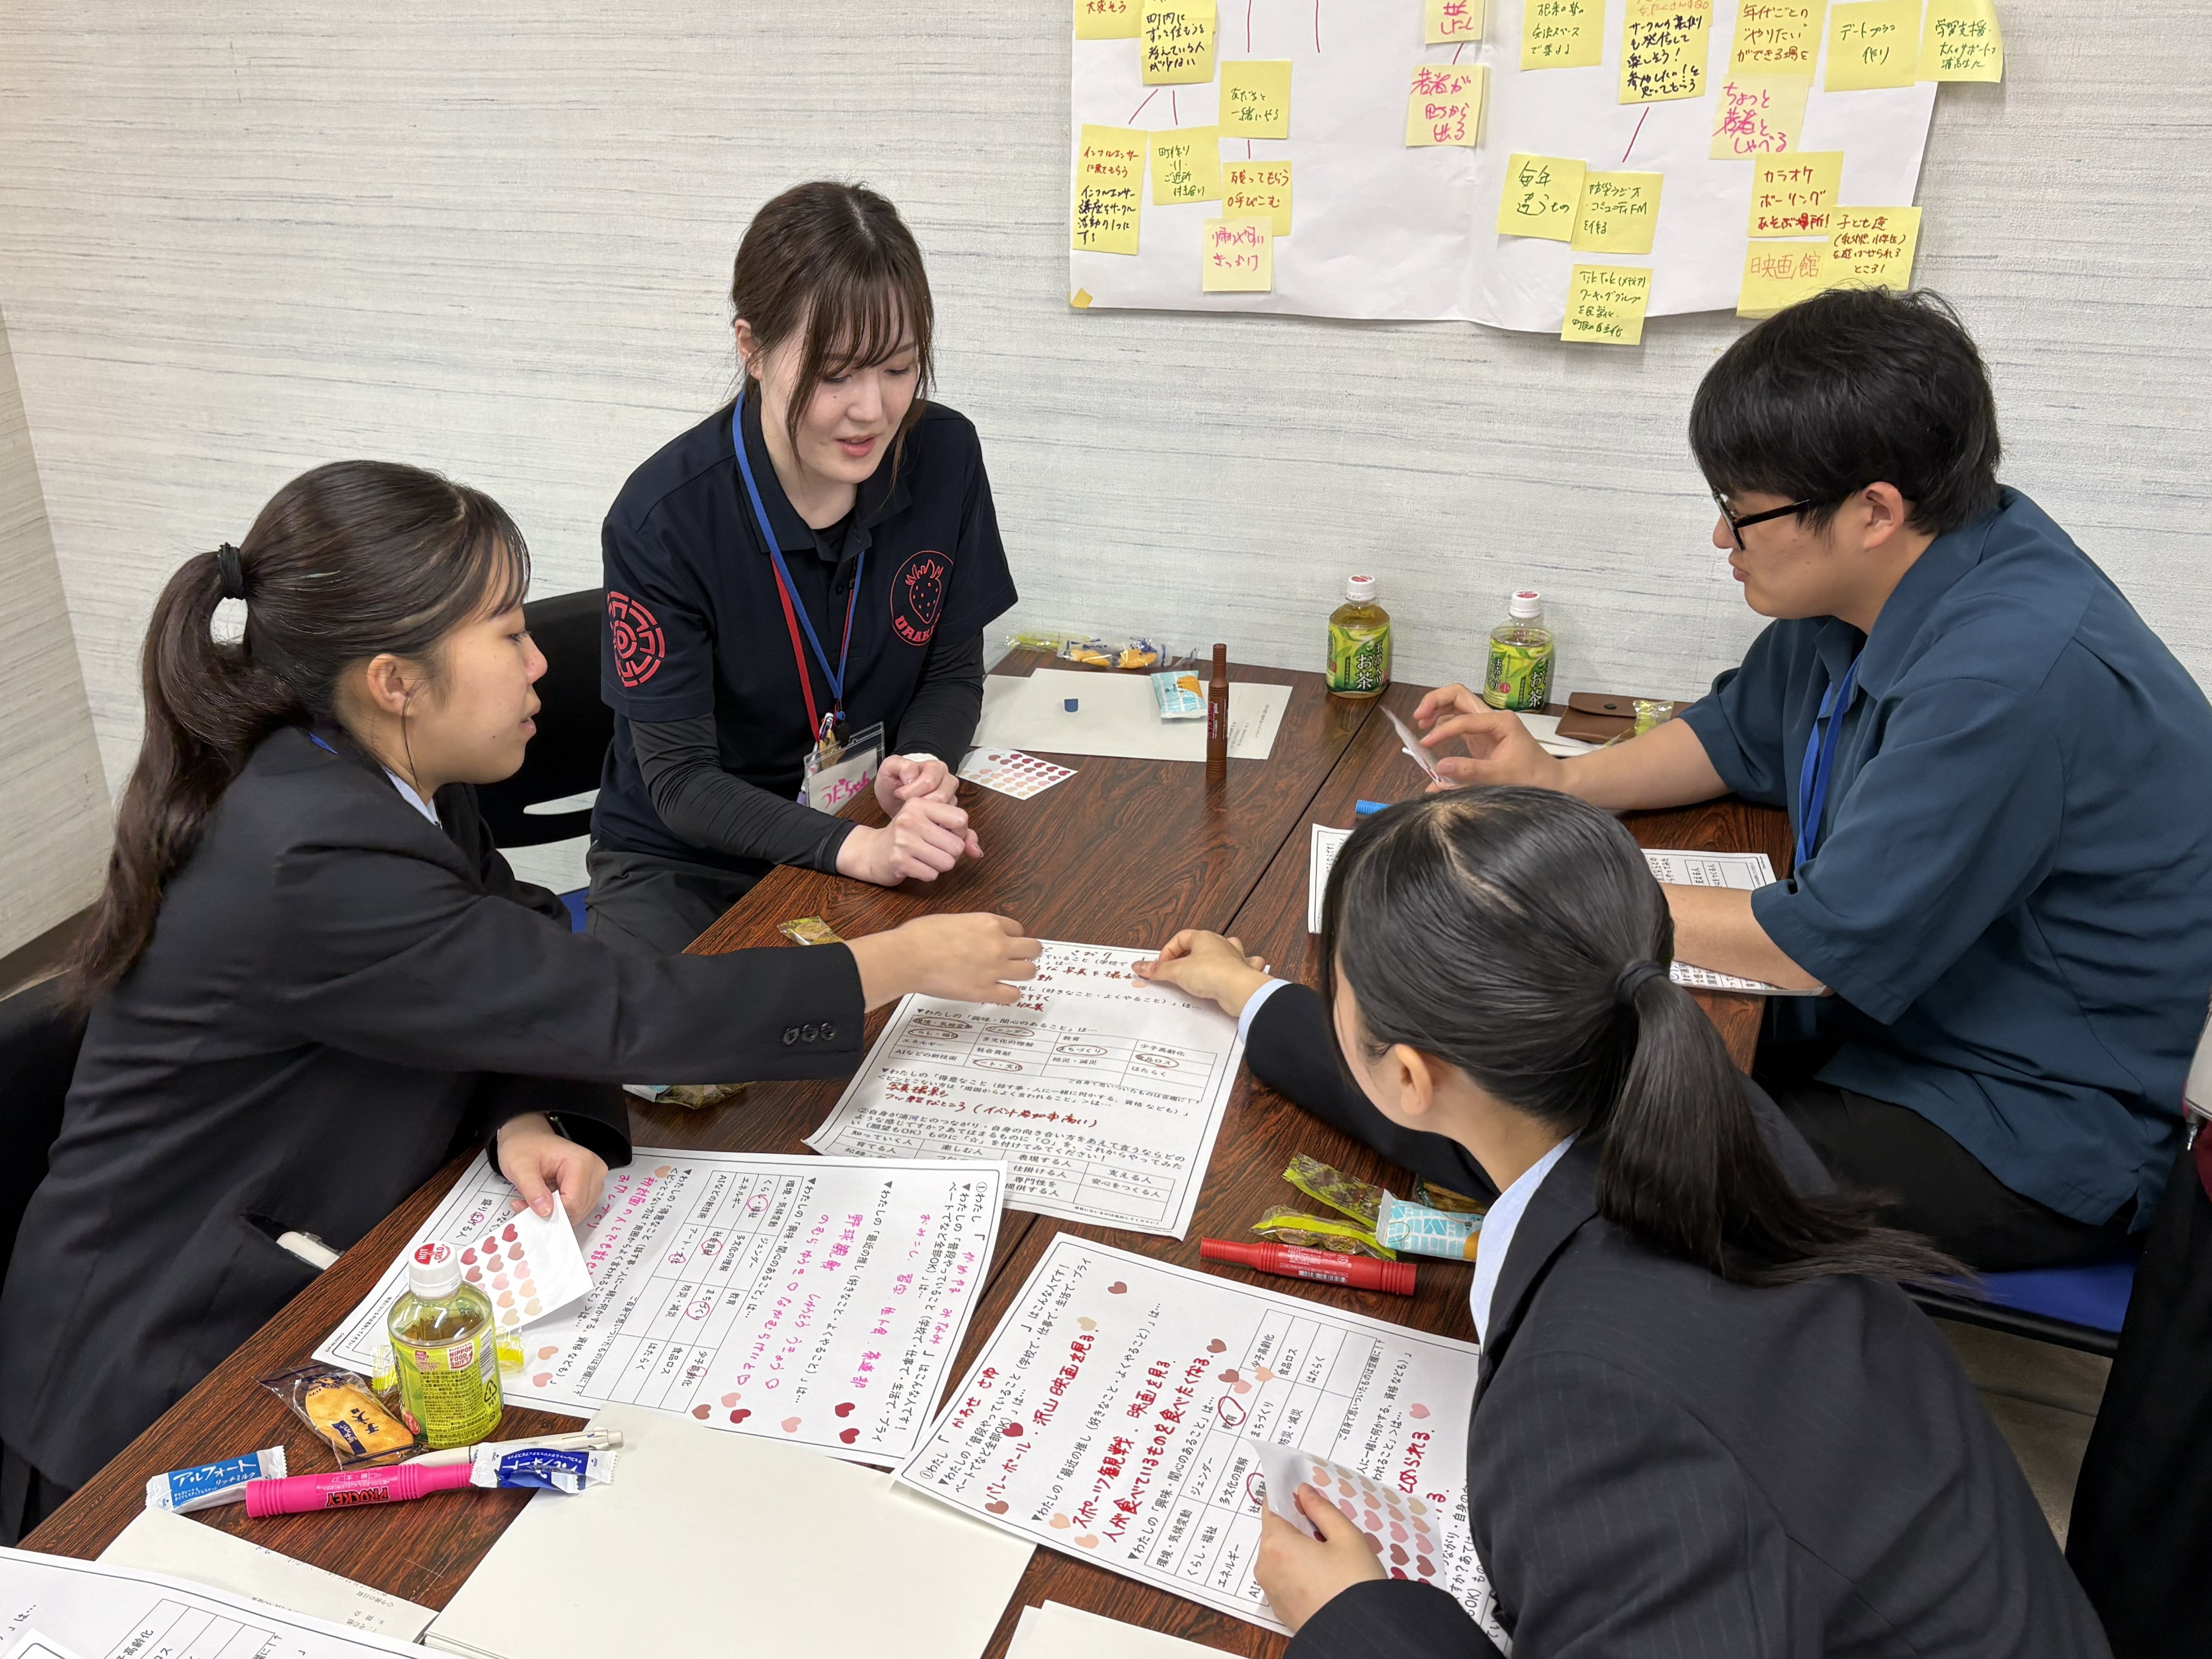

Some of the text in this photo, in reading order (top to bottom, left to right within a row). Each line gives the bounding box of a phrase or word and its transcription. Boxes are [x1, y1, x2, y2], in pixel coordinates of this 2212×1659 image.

[1722, 81, 1770, 109] ちょっと
[1764, 166, 1814, 184] カラオケ
[1760, 190, 1826, 208] ボーリング
[1750, 250, 1821, 280] 映画館
[1355, 654, 1373, 689] お茶
[1528, 671, 1542, 707] お茶
[851, 1130, 912, 1146] 知っていく人
[857, 1141, 896, 1154] 育てる人
[941, 1144, 983, 1156] 楽しむ人
[1013, 1165, 1067, 1179] 仕掛ける人
[1018, 1154, 1072, 1167] 表現する人
[1091, 1178, 1160, 1198] 安心をつくる人
[1109, 1169, 1152, 1184] 支える人
[698, 1176, 727, 1219] AIなどの新技術
[733, 1178, 749, 1209] エネルギー
[768, 1181, 795, 1227] 環境・気候変動
[418, 1248, 429, 1260] HOT
[719, 1236, 746, 1272] 多文化の理解
[750, 1239, 769, 1268] ジェンダー
[666, 1286, 692, 1317] 防災・減災
[727, 1293, 740, 1305] 教育
[449, 1345, 473, 1357] NIPPON
[450, 1354, 467, 1363] FOOD
[450, 1358, 470, 1367] SHIFT
[637, 1343, 658, 1370] はたらく
[662, 1348, 683, 1374] 食品ロス
[1279, 1350, 1298, 1375] 食品ロス
[1306, 1357, 1325, 1384] はたらく
[488, 1396, 497, 1407] PET
[1251, 1403, 1274, 1437] まちづくり
[172, 1454, 257, 1489] アルフォート
[214, 1470, 256, 1487] リッチミルク
[1191, 1458, 1212, 1496] ジェンダー
[1220, 1458, 1249, 1505] 多文化の理解
[325, 1486, 390, 1507] PROCKEY
[1157, 1510, 1193, 1568] 環境・気候変動
[1188, 1527, 1218, 1576] くらし・福祉
[1219, 1545, 1240, 1588] エネルギー
